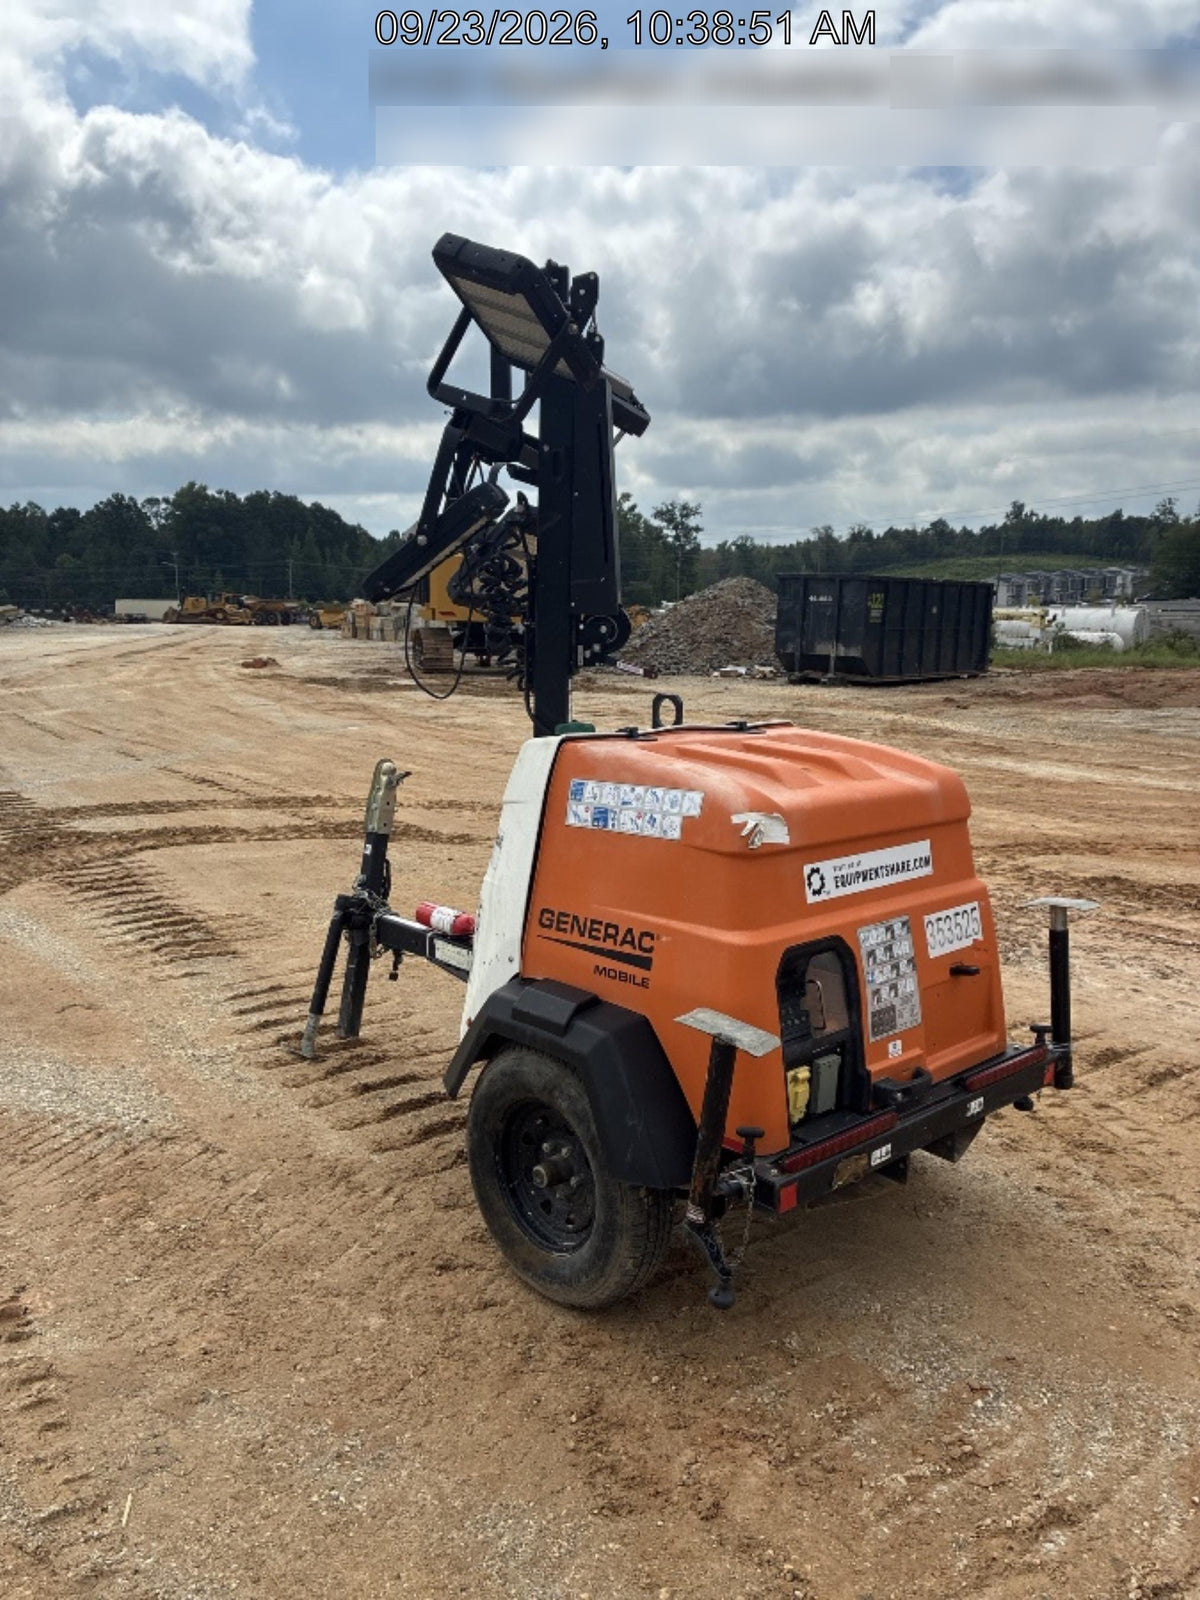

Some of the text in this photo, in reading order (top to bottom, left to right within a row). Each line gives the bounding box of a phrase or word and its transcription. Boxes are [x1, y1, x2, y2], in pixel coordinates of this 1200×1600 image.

[833, 855, 930, 889] EQUIPMENTSHARE.COM
[538, 907, 656, 954] GENERAC
[926, 906, 980, 950] 353525
[593, 965, 650, 989] MOBILE
